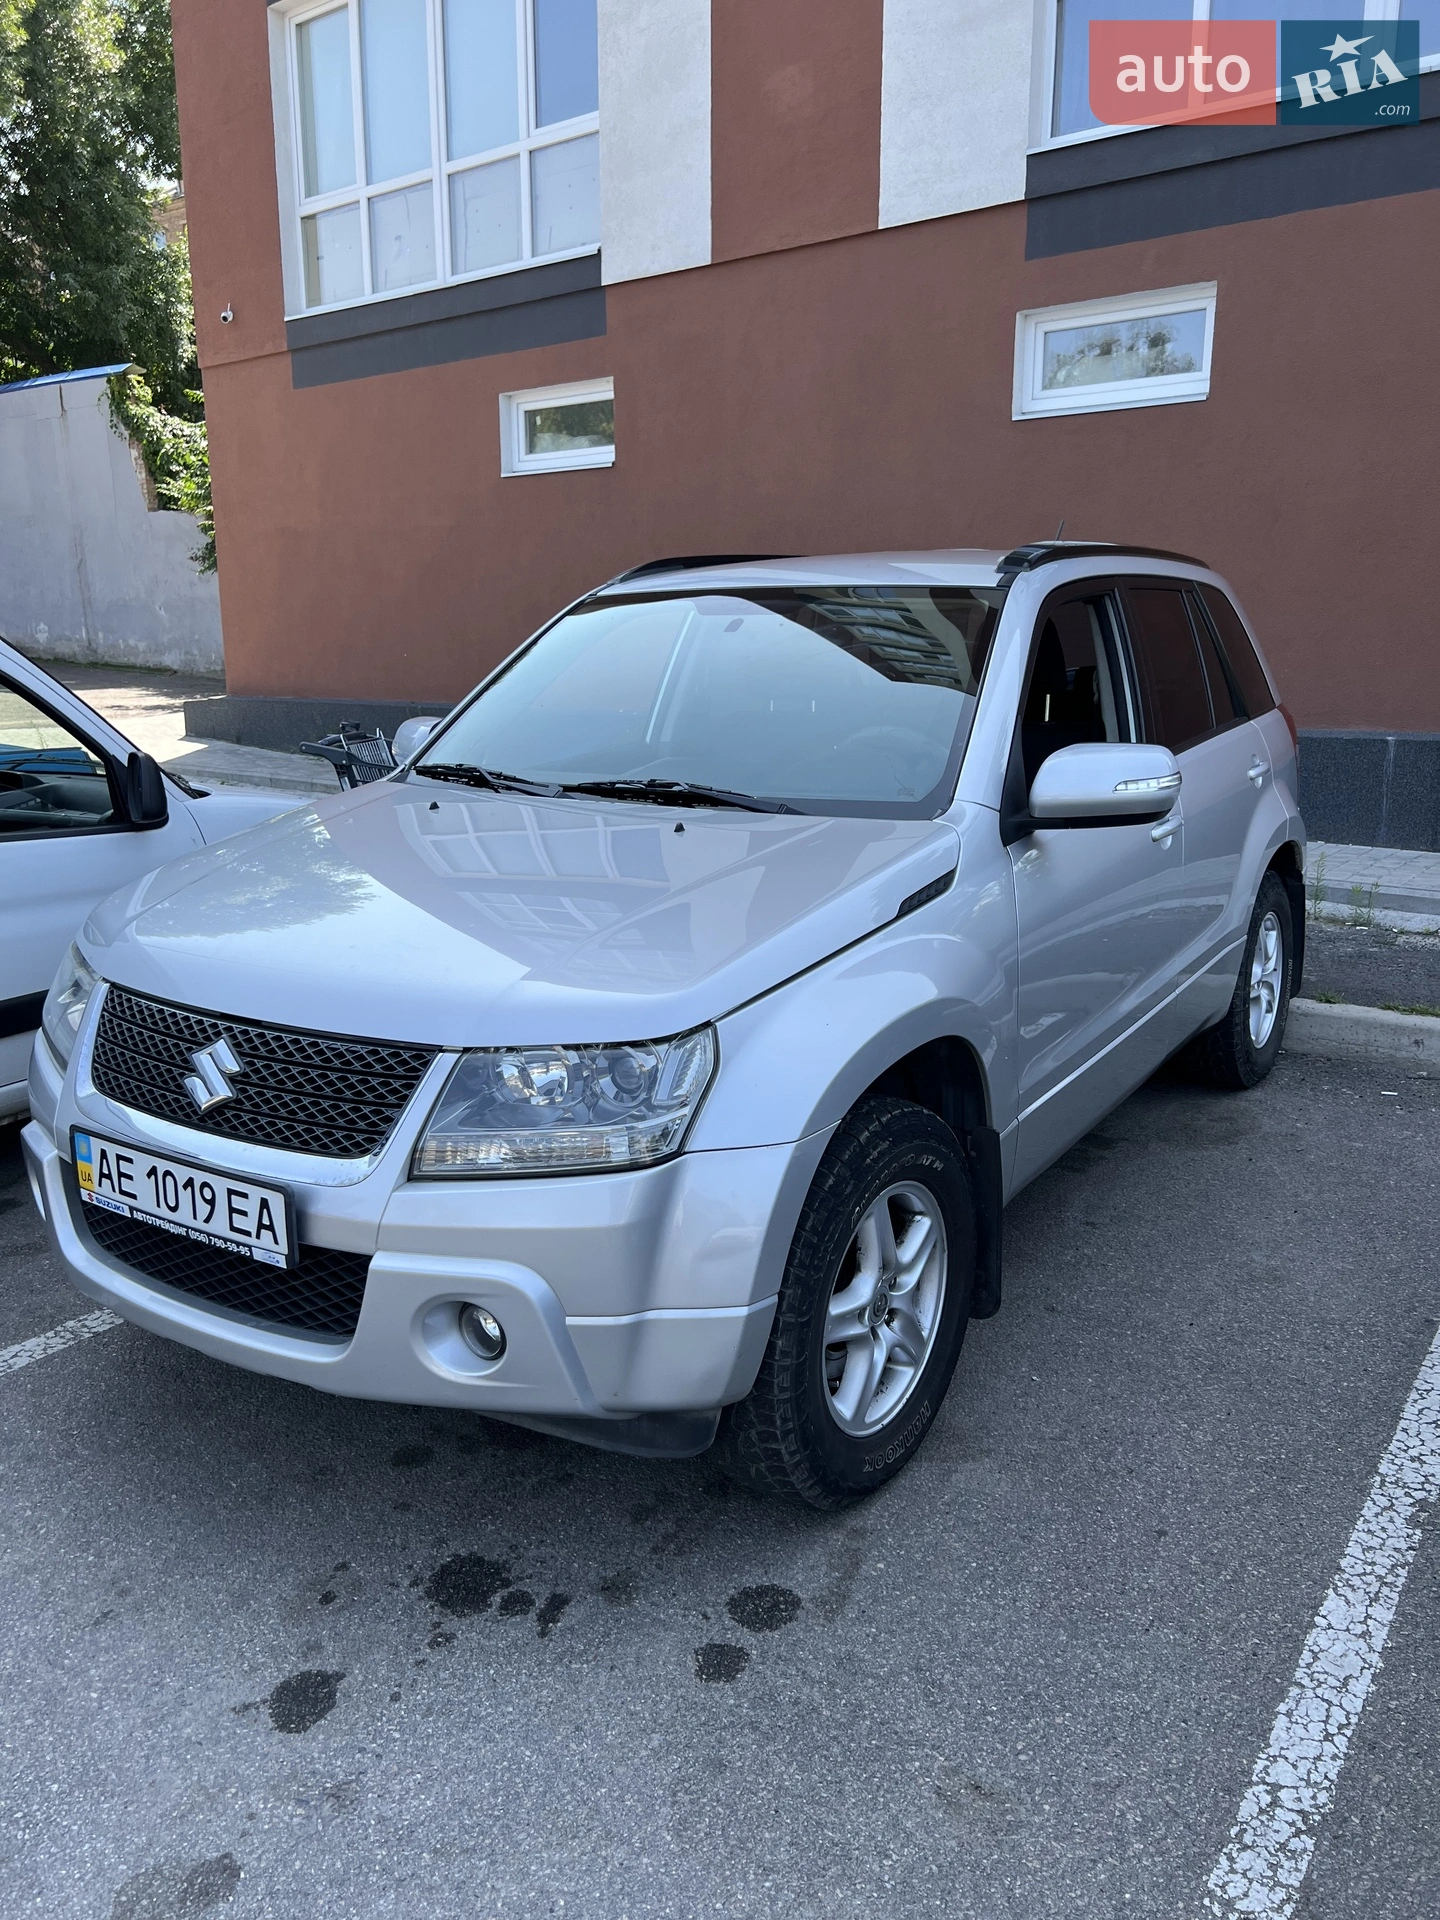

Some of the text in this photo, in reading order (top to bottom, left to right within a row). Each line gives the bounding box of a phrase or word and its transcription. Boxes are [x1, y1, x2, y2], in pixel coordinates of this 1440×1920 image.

[80, 1169, 94, 1185] UA
[95, 1196, 126, 1214] SUZUKI
[98, 1147, 280, 1246] AE 1019 EA
[132, 1210, 188, 1237] АВТОТРЕЙДІНГ
